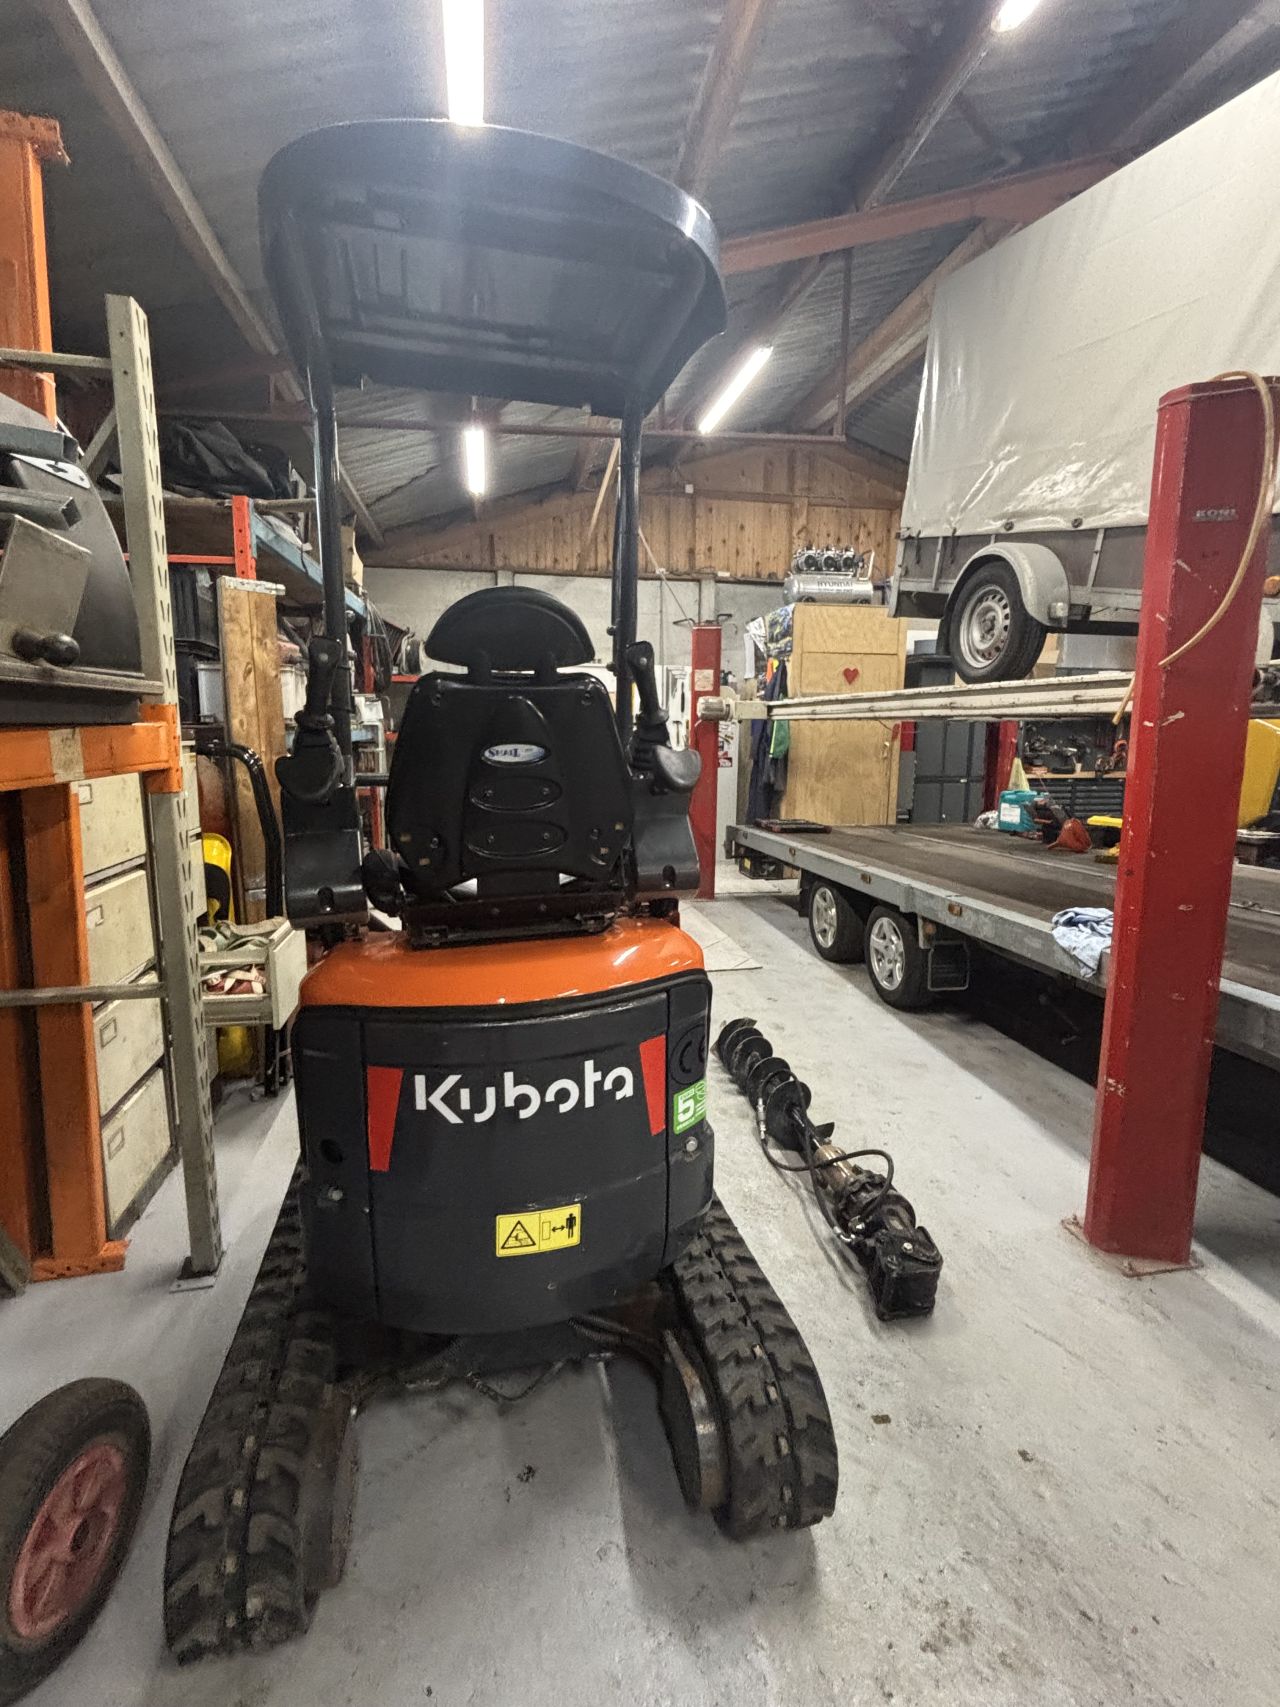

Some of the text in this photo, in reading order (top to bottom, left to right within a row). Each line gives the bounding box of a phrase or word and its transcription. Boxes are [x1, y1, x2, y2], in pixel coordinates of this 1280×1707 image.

[817, 580, 853, 588] HYUNDAI
[414, 1059, 634, 1124] Kubota
[677, 1088, 695, 1123] 5
